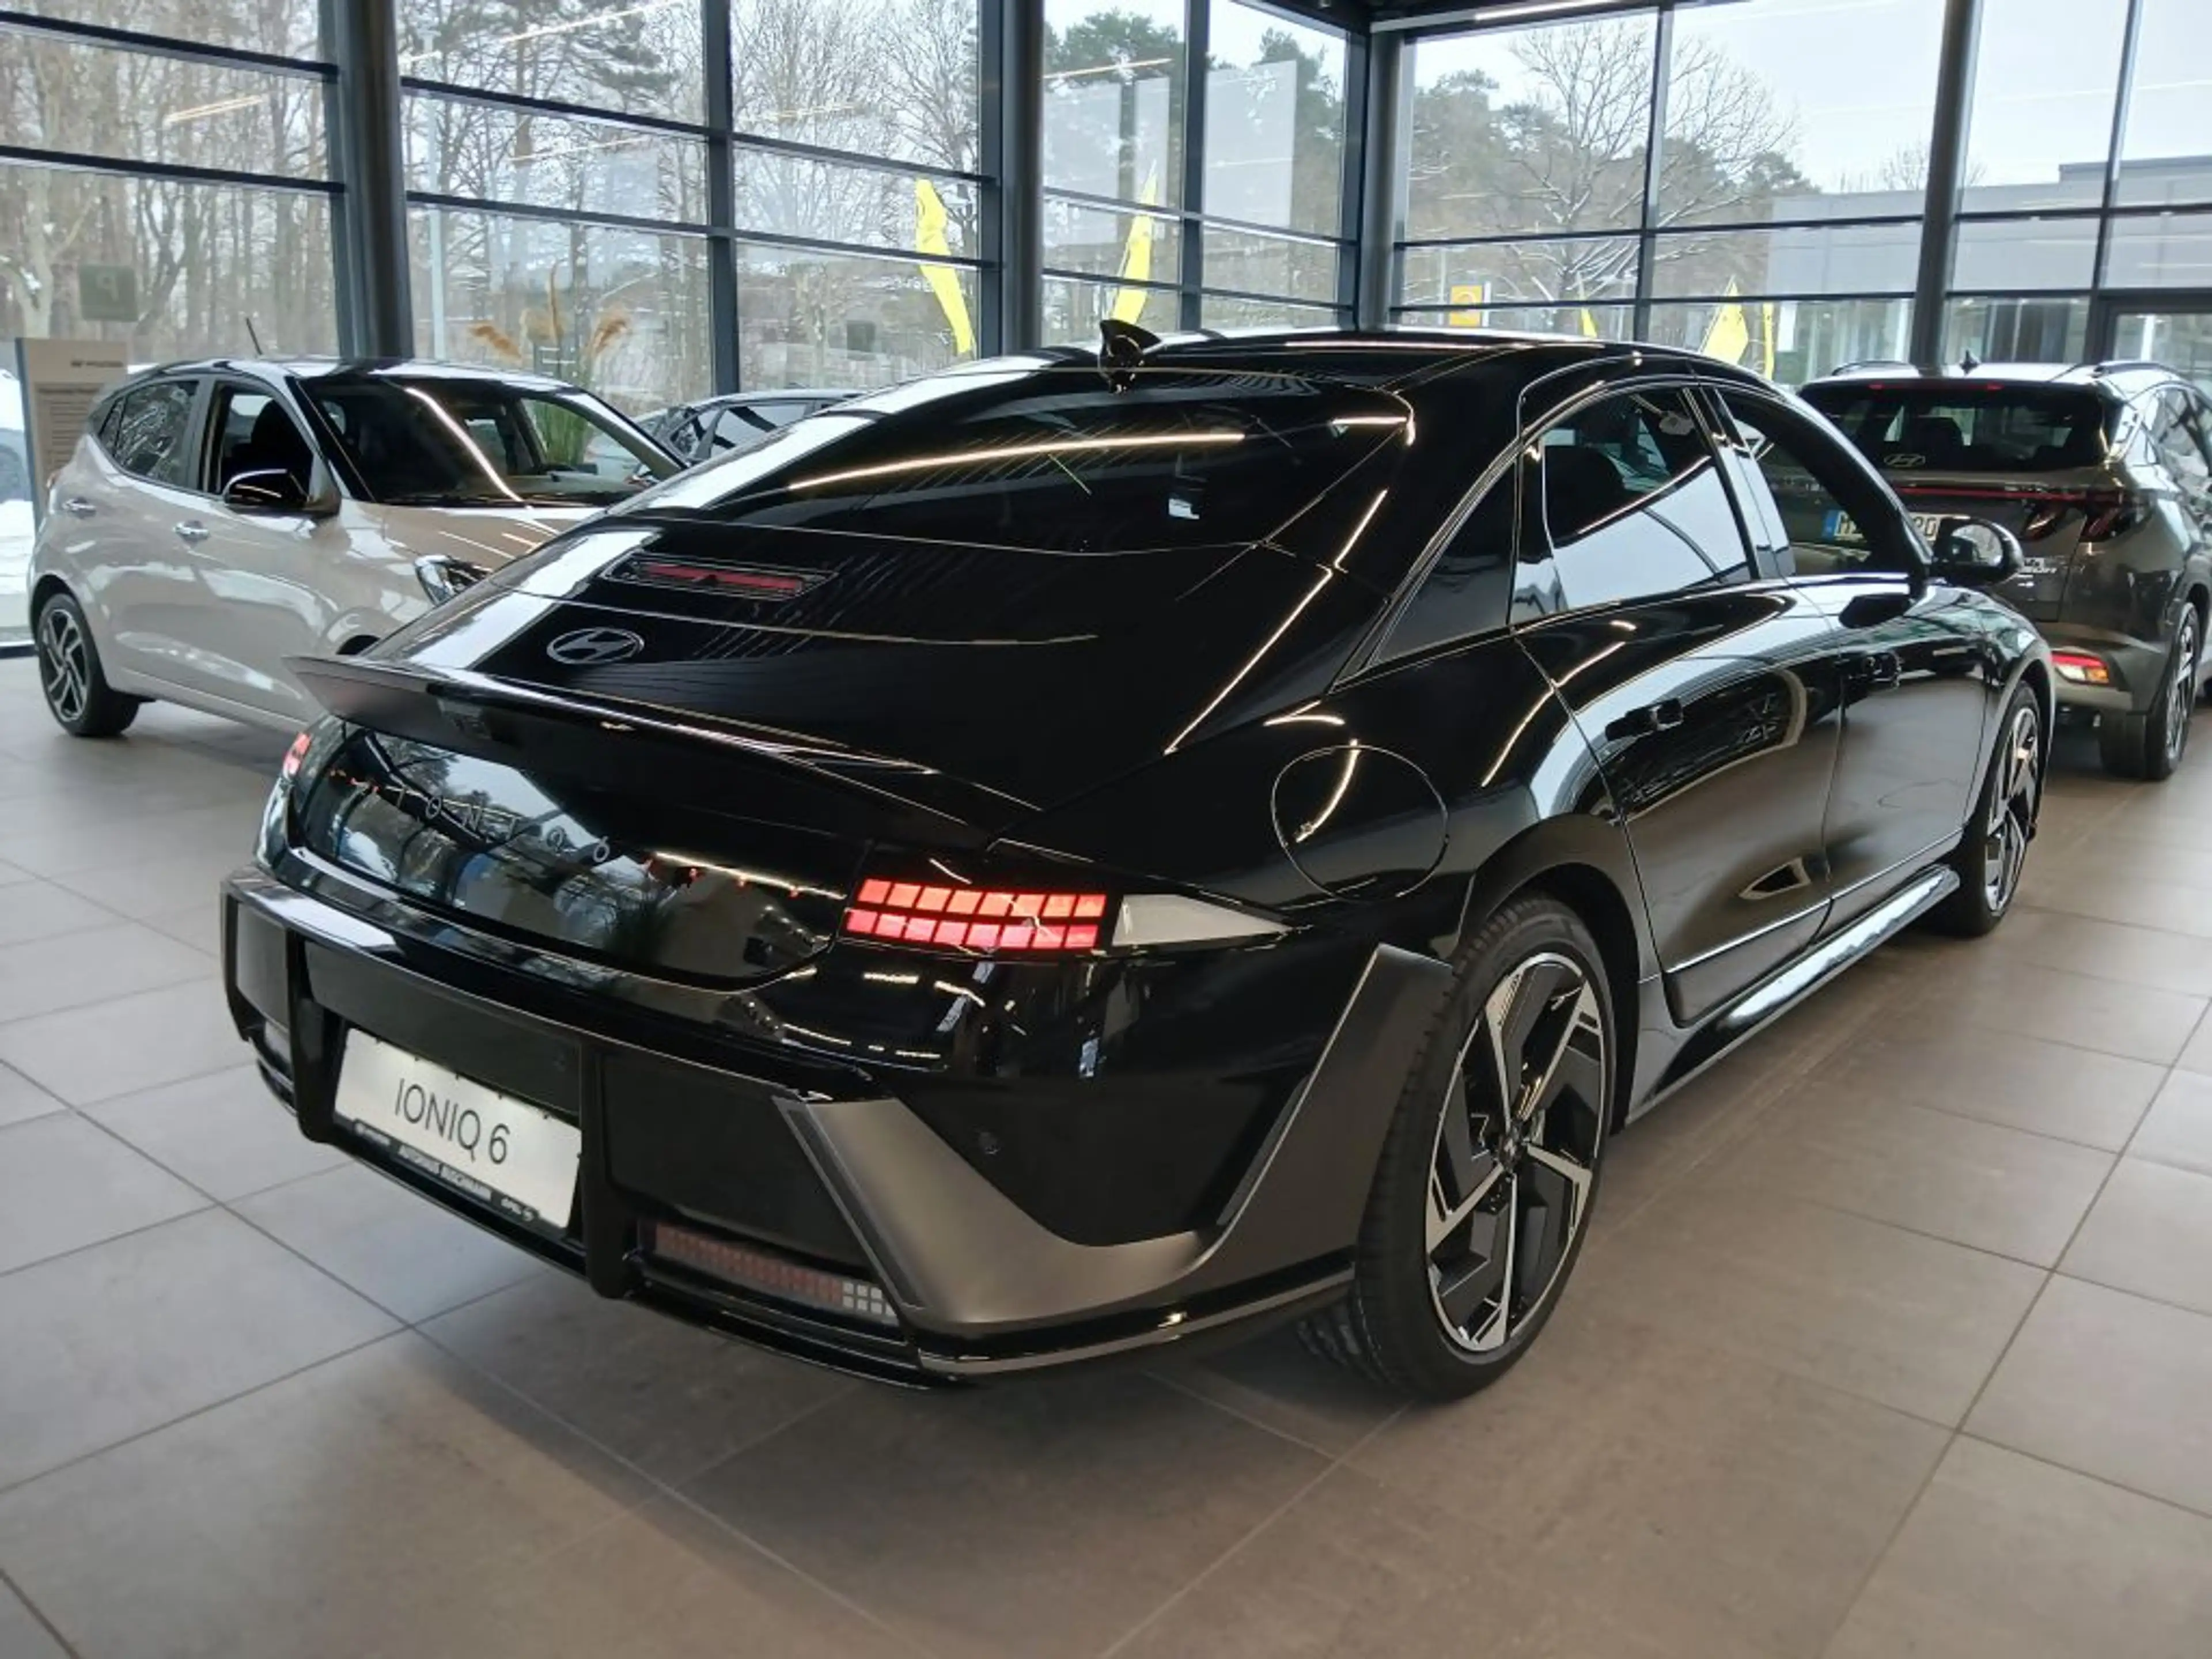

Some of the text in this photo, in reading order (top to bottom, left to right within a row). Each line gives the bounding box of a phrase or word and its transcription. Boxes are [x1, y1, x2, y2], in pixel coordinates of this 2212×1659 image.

[396, 787, 611, 863] IONIQ 6
[395, 1078, 480, 1162] IONIQ
[488, 1124, 510, 1165] 6
